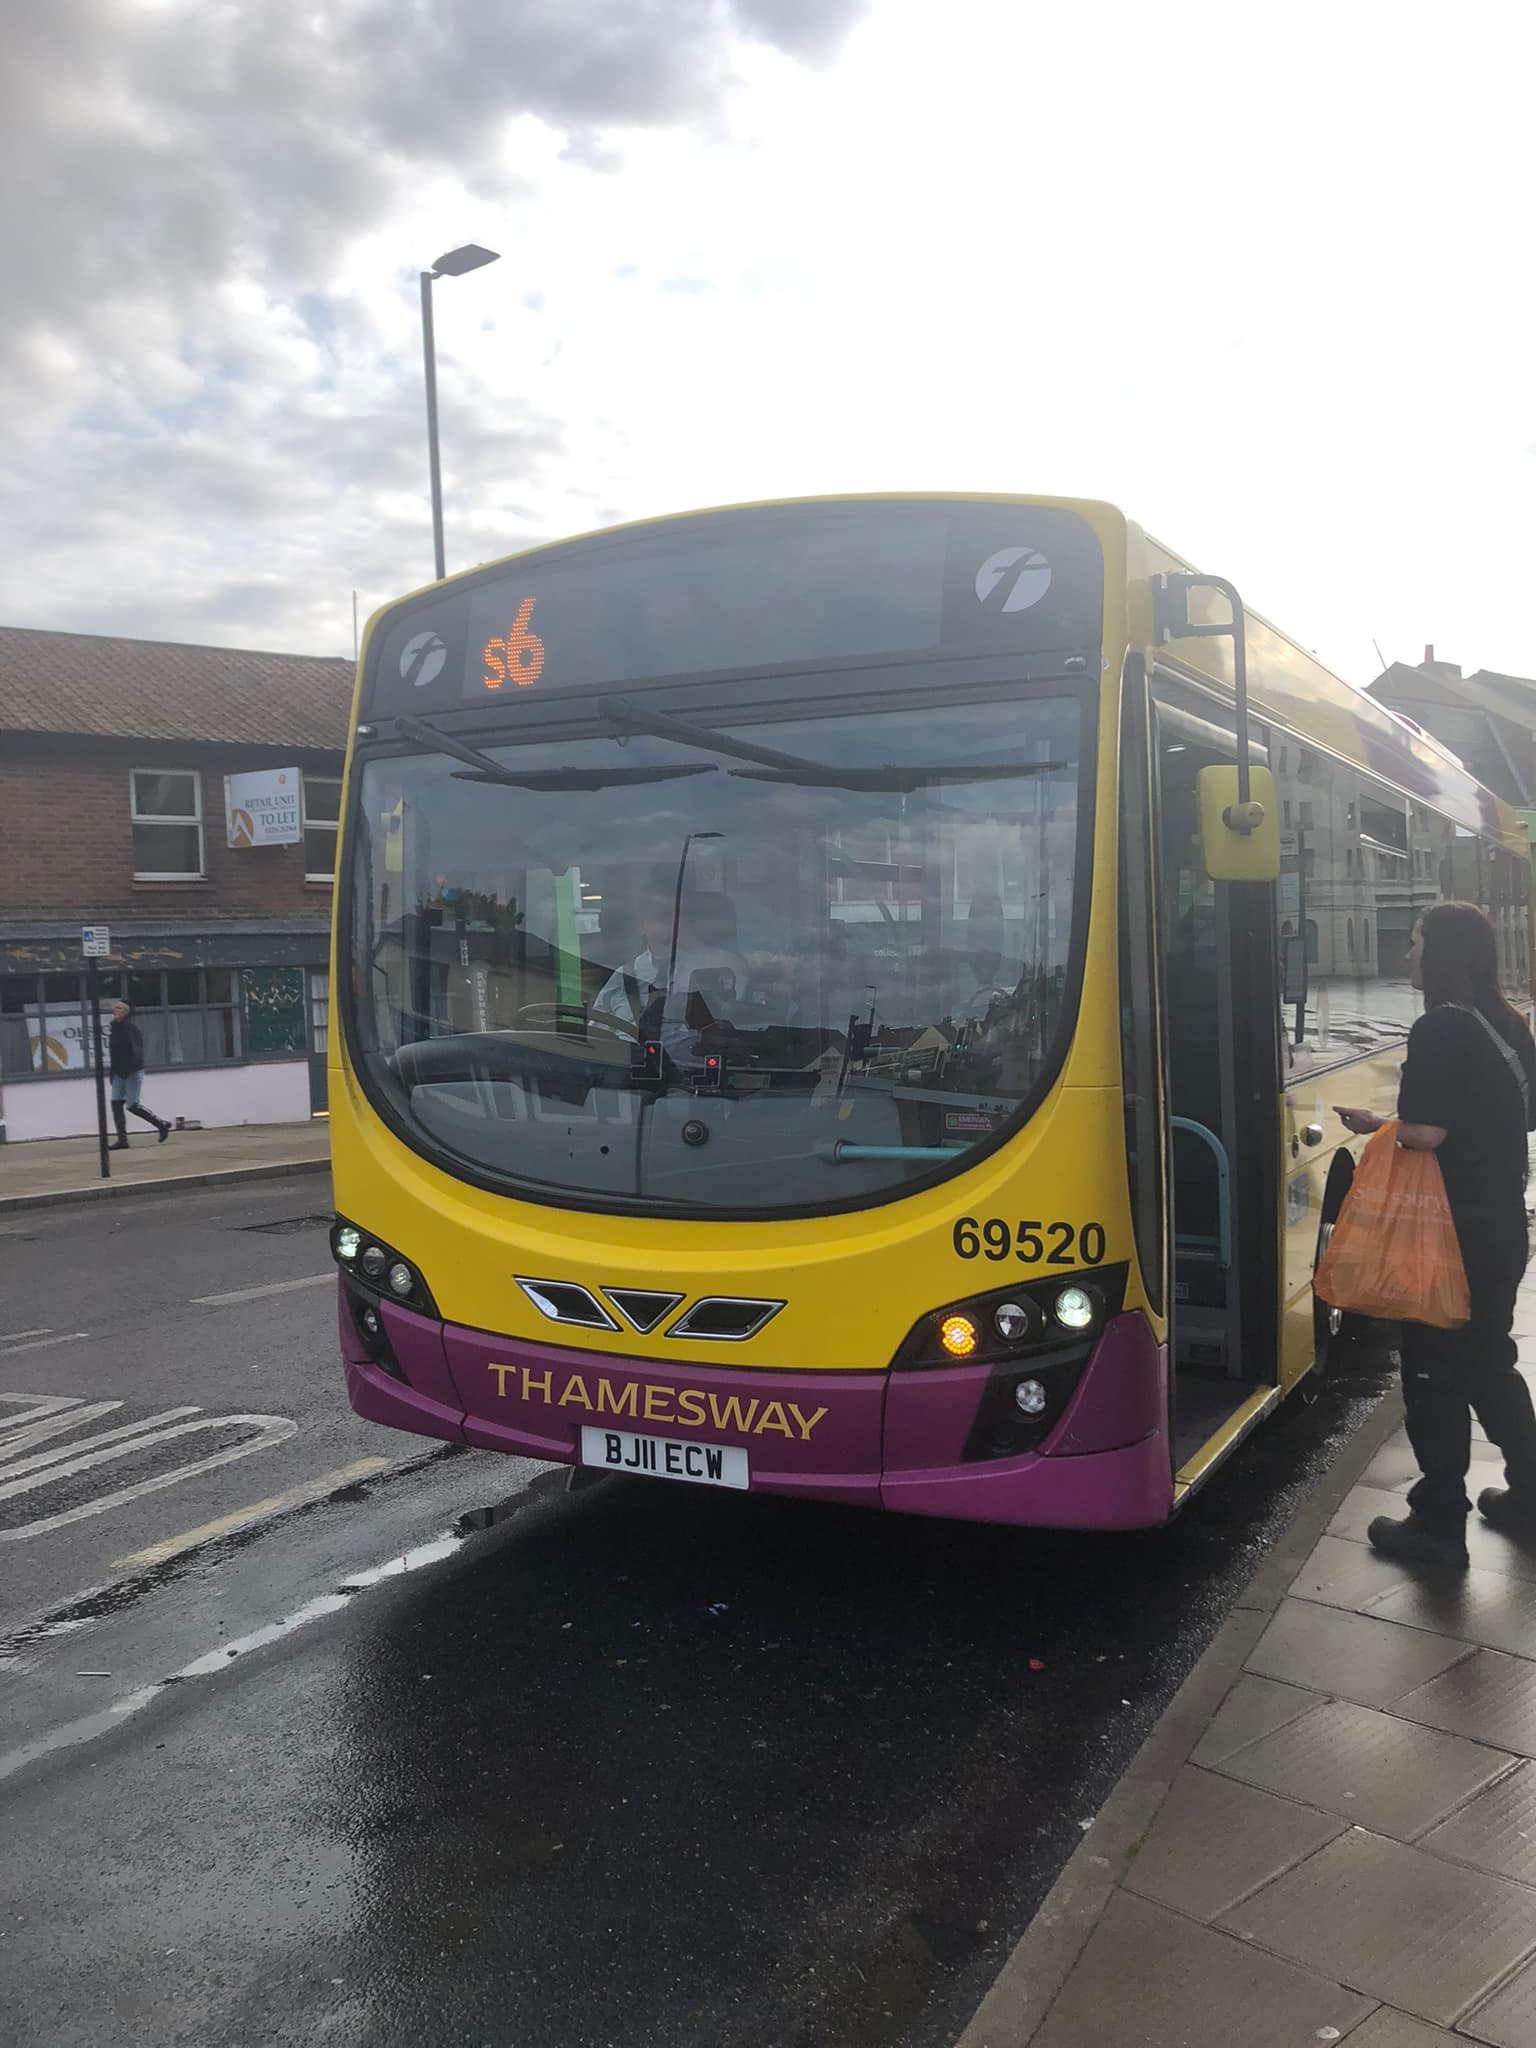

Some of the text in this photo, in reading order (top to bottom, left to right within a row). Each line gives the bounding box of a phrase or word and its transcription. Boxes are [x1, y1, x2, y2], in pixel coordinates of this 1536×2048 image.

[245, 795, 295, 808] RETAIL UNIT
[261, 811, 297, 825] TO LET
[953, 1217, 1106, 1265] 69520
[487, 1363, 830, 1441] THAMESWAY
[605, 1433, 723, 1480] BJ11 ECW
